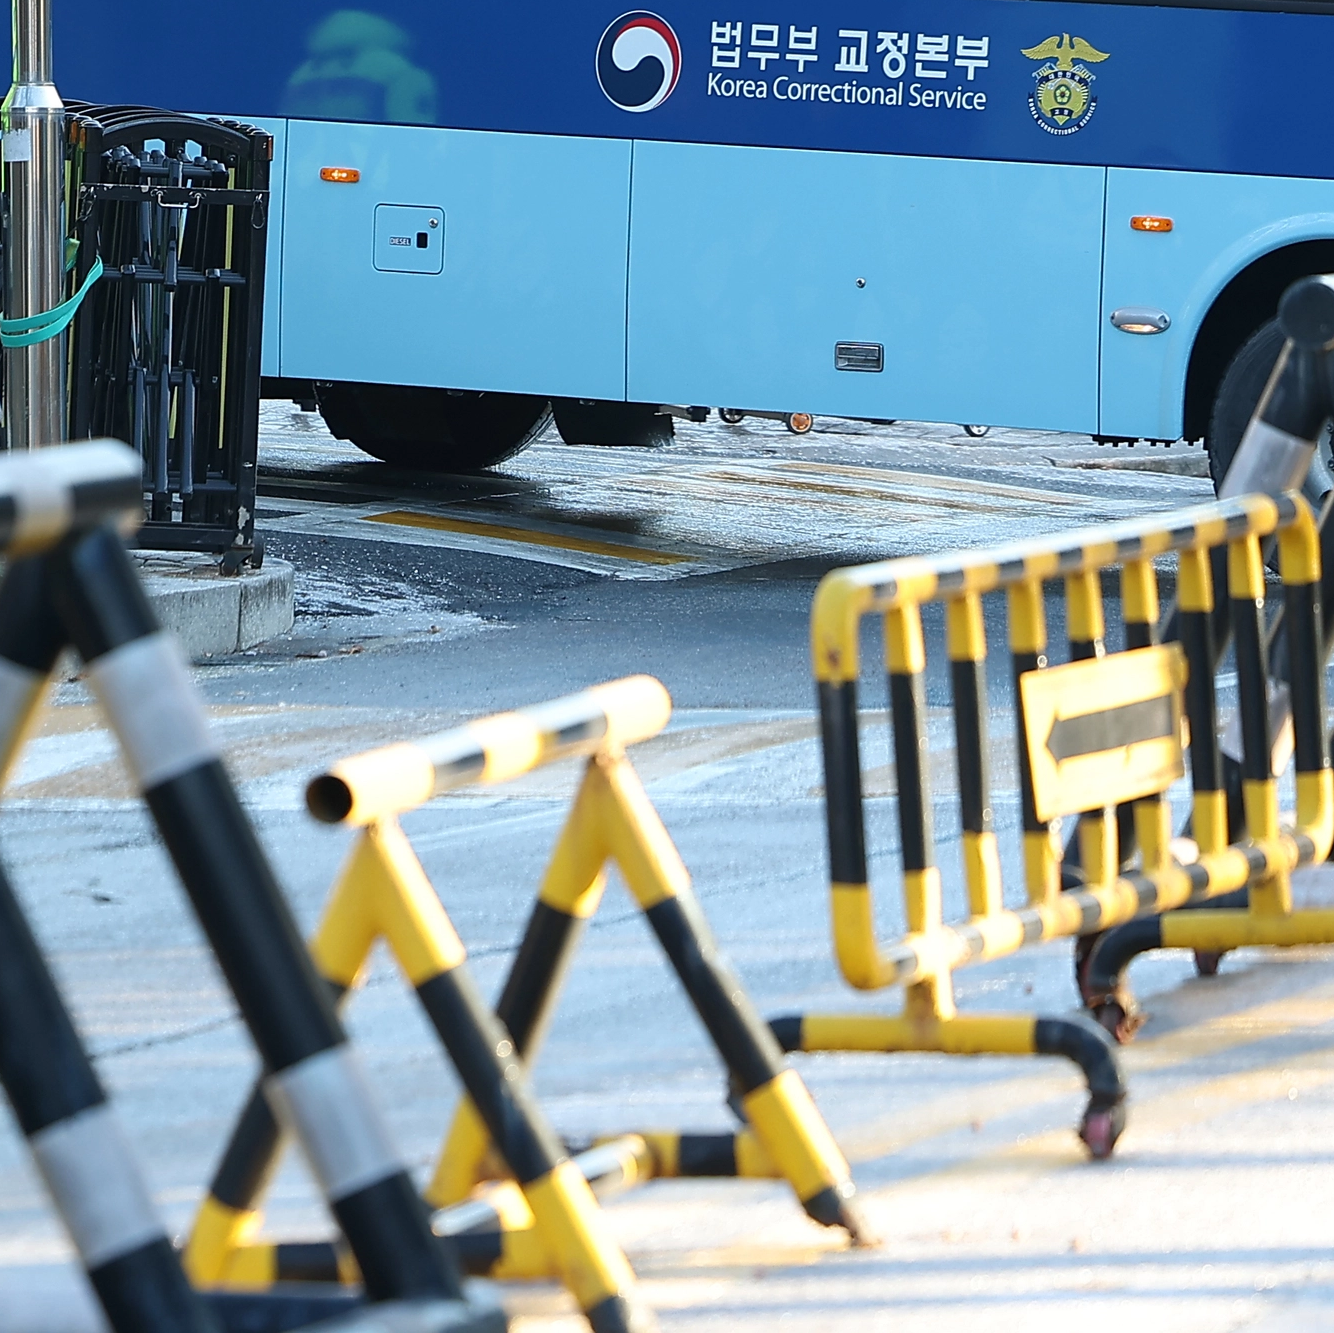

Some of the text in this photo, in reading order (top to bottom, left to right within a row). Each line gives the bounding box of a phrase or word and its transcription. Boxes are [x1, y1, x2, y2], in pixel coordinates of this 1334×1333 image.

[711, 21, 989, 80] 법무부 교정본부
[707, 72, 987, 110] Korea Correctional Service
[390, 237, 410, 245] DIESEL
